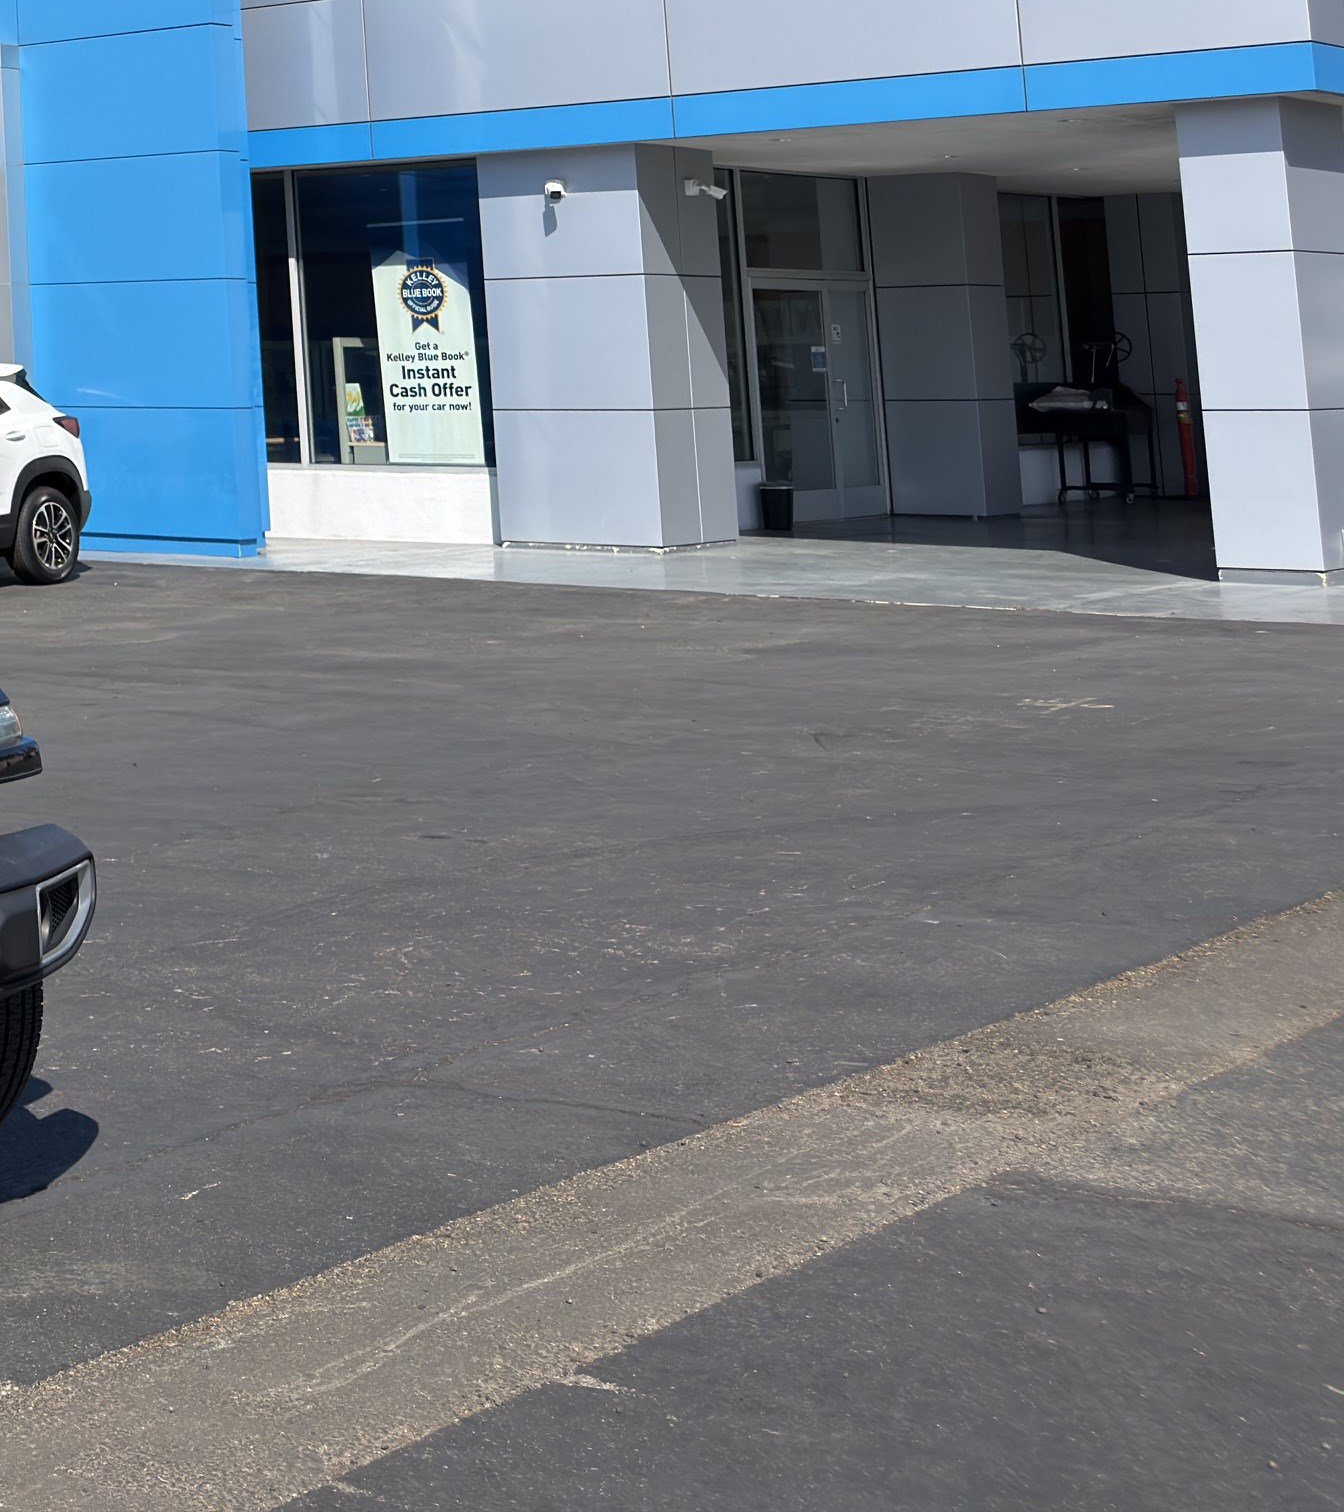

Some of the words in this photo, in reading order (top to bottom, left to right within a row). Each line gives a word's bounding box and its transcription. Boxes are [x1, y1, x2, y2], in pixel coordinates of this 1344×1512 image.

[405, 272, 439, 286] KELLEY
[402, 289, 421, 298] BLUE
[422, 288, 442, 297] BOOK
[415, 342, 431, 350] Get
[386, 353, 415, 363] Kelley
[418, 352, 439, 361] Blue
[401, 365, 457, 379] Instant
[389, 383, 427, 397] Cash
[432, 383, 472, 397] Offer
[393, 402, 406, 411] for
[408, 403, 429, 412] your
[432, 403, 447, 411] car
[449, 402, 472, 411] now!
